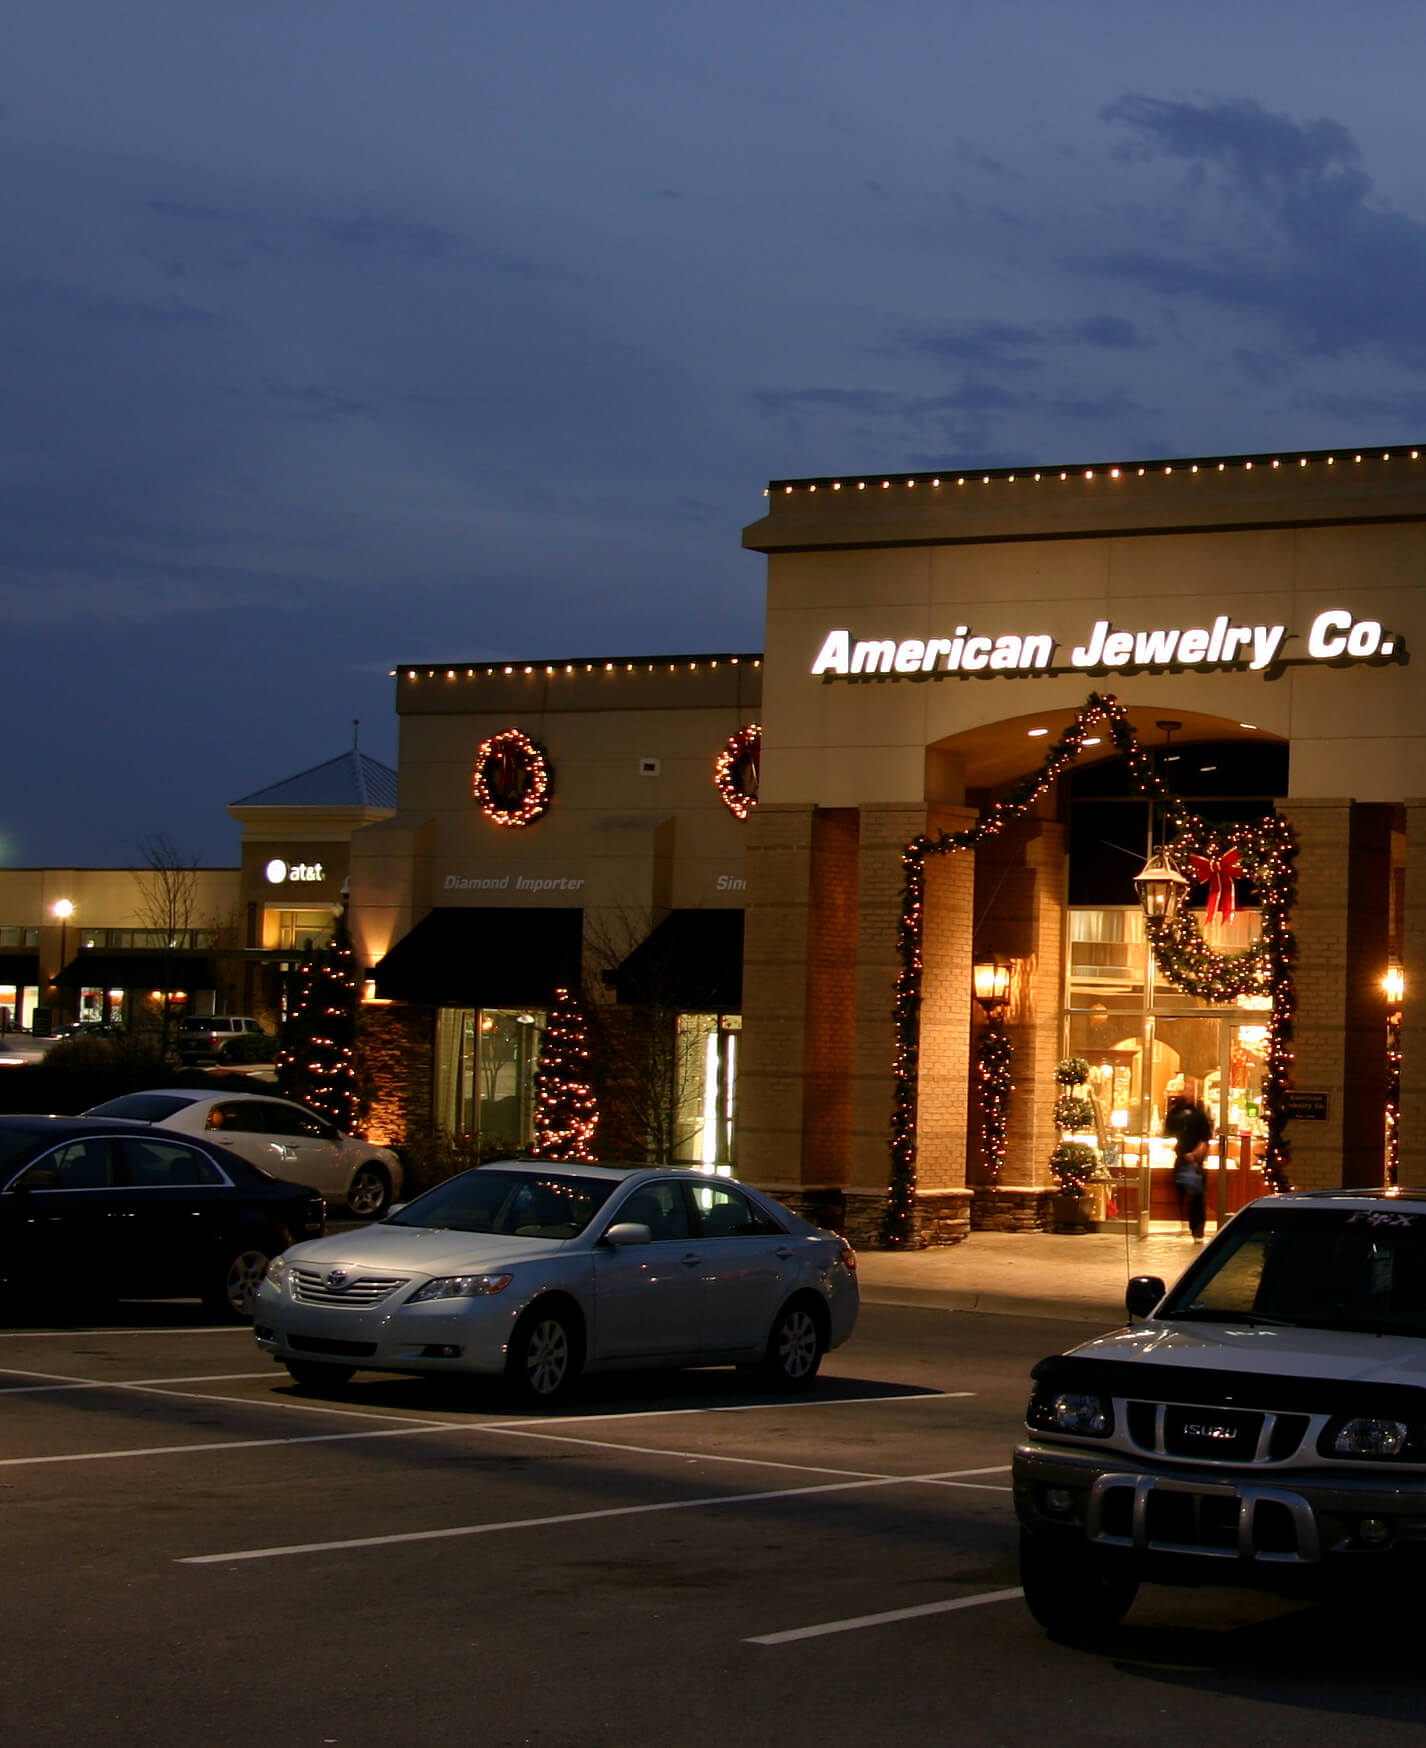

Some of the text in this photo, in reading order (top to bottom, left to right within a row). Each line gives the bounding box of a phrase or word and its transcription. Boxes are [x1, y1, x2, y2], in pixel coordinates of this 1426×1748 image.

[811, 609, 1394, 675] American Jewelry Co.
[289, 863, 323, 881] at&t
[444, 875, 584, 892] Diamond Importer
[1183, 1424, 1239, 1438] ISUZU
